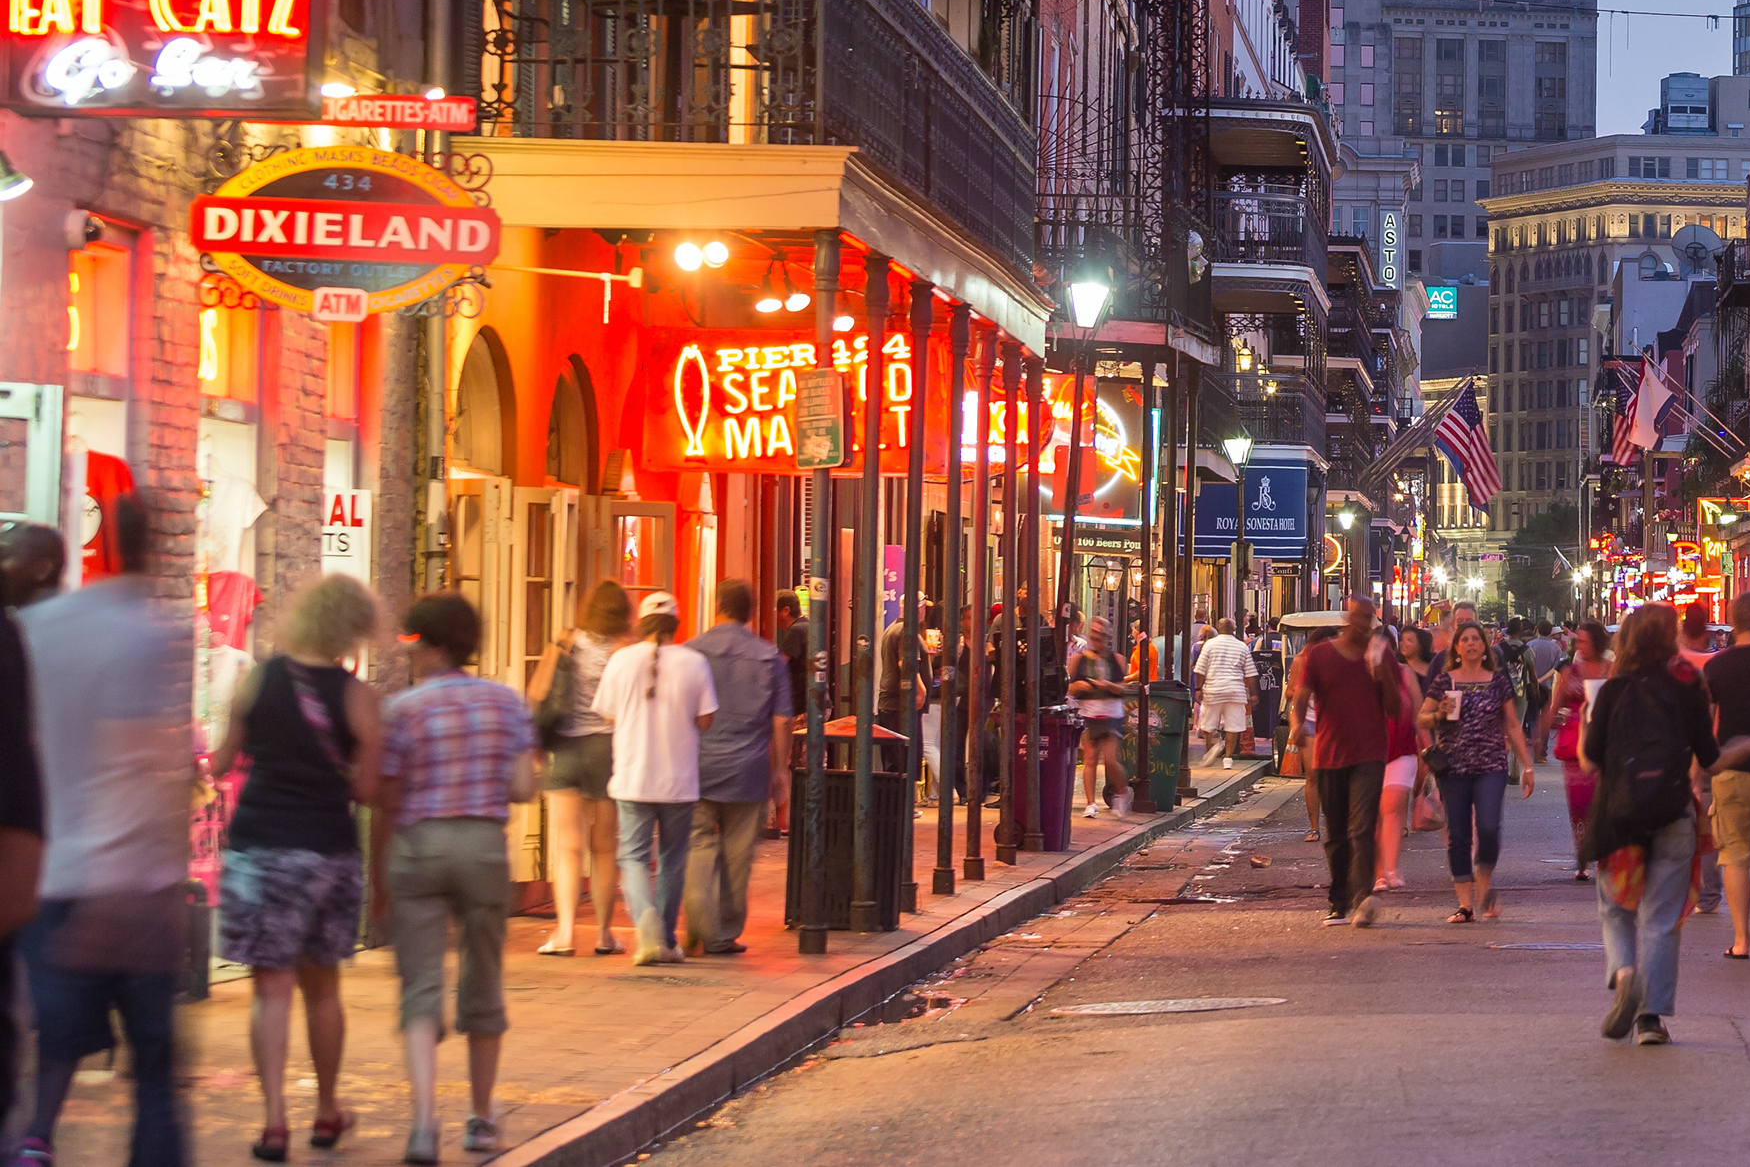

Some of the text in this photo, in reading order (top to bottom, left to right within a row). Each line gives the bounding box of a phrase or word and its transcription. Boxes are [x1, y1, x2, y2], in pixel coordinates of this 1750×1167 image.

[323, 173, 372, 193] 434
[203, 207, 491, 252] DIXIELAND
[1382, 213, 1396, 289] ASTO
[261, 260, 343, 276] FACTORY
[350, 264, 420, 279] OUTLET
[228, 259, 456, 309] SOFT DRINKS CIGARETTES
[318, 293, 361, 316] ATM
[1430, 291, 1453, 303] AC
[716, 343, 817, 371] PIER
[723, 363, 912, 413] SEAD
[1216, 517, 1296, 530] ROYA SONESTA HOTEL
[1077, 537, 1094, 546] 100
[1096, 537, 1121, 548] Beers
